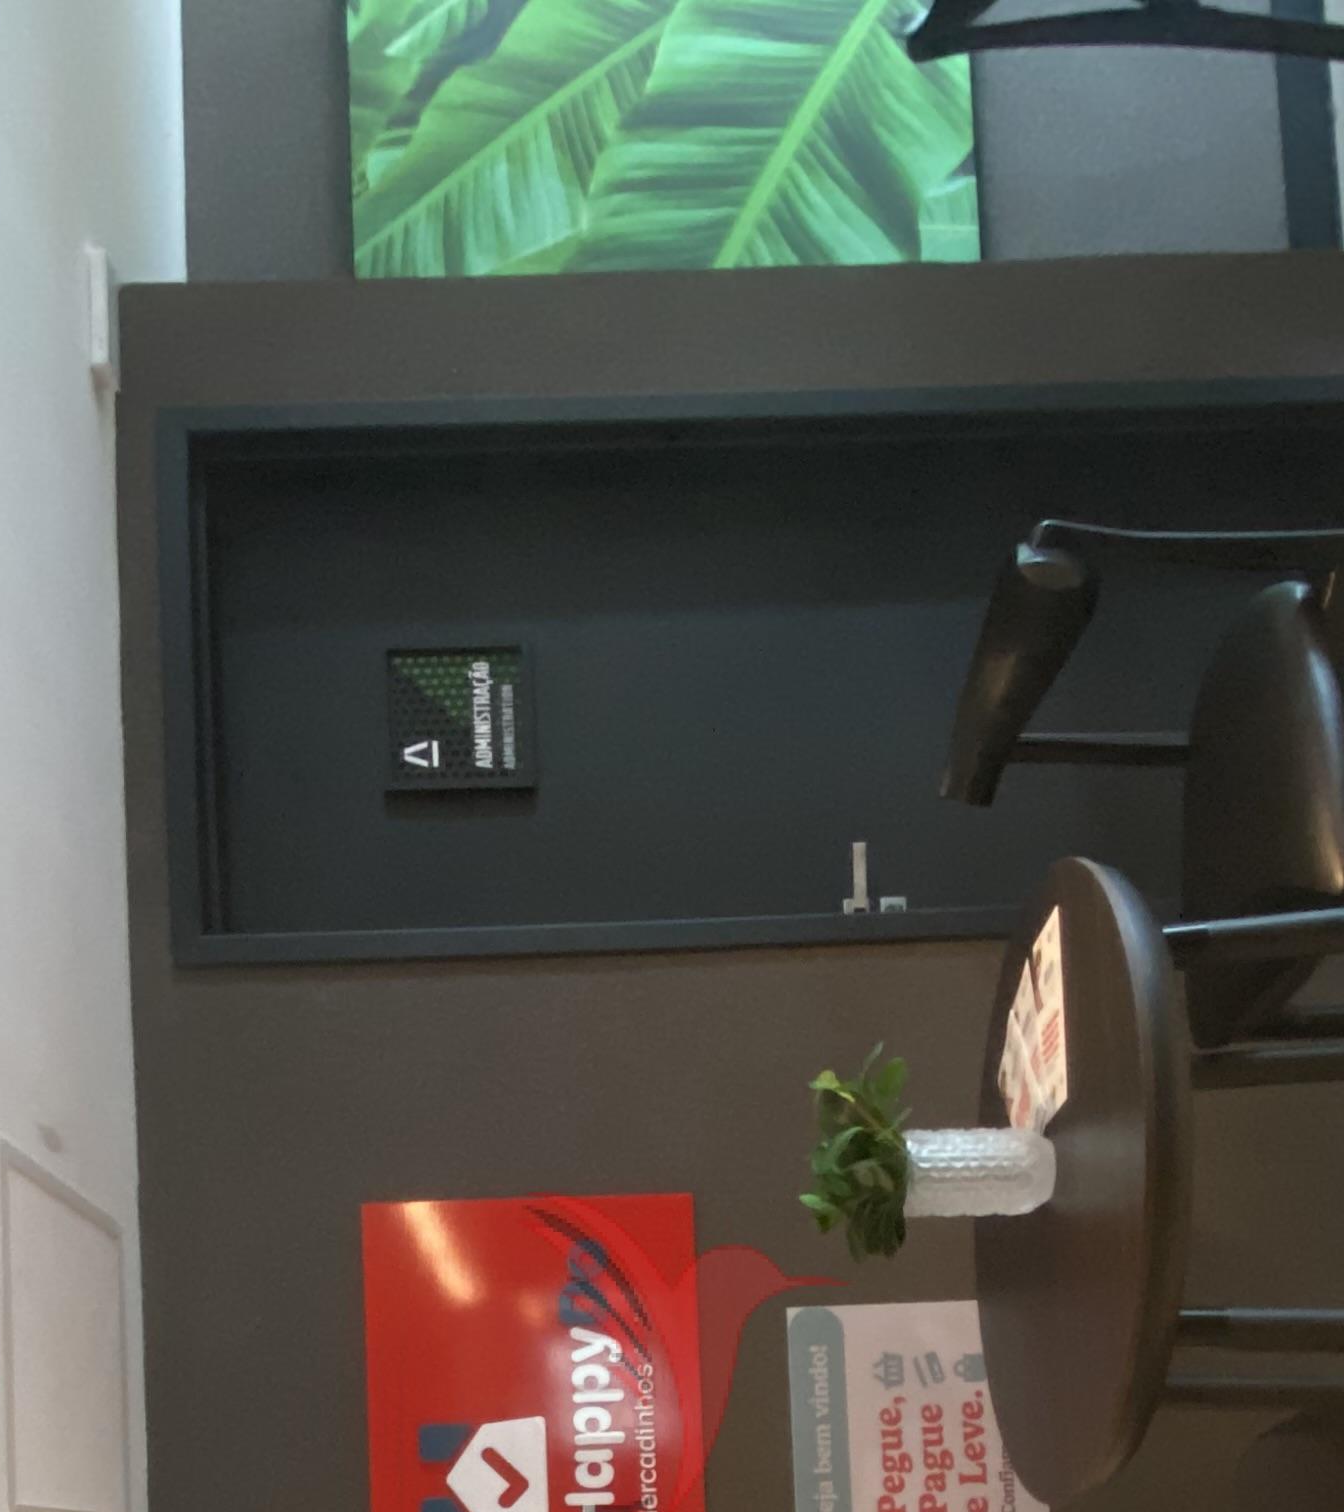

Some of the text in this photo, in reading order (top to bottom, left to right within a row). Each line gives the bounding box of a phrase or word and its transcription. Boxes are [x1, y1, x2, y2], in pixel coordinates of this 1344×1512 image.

[468, 662, 494, 768] ADMINISTRAÇÃO
[809, 1345, 831, 1418] vindo!
[812, 1424, 833, 1473] bem
[956, 1389, 987, 1485] Leve.
